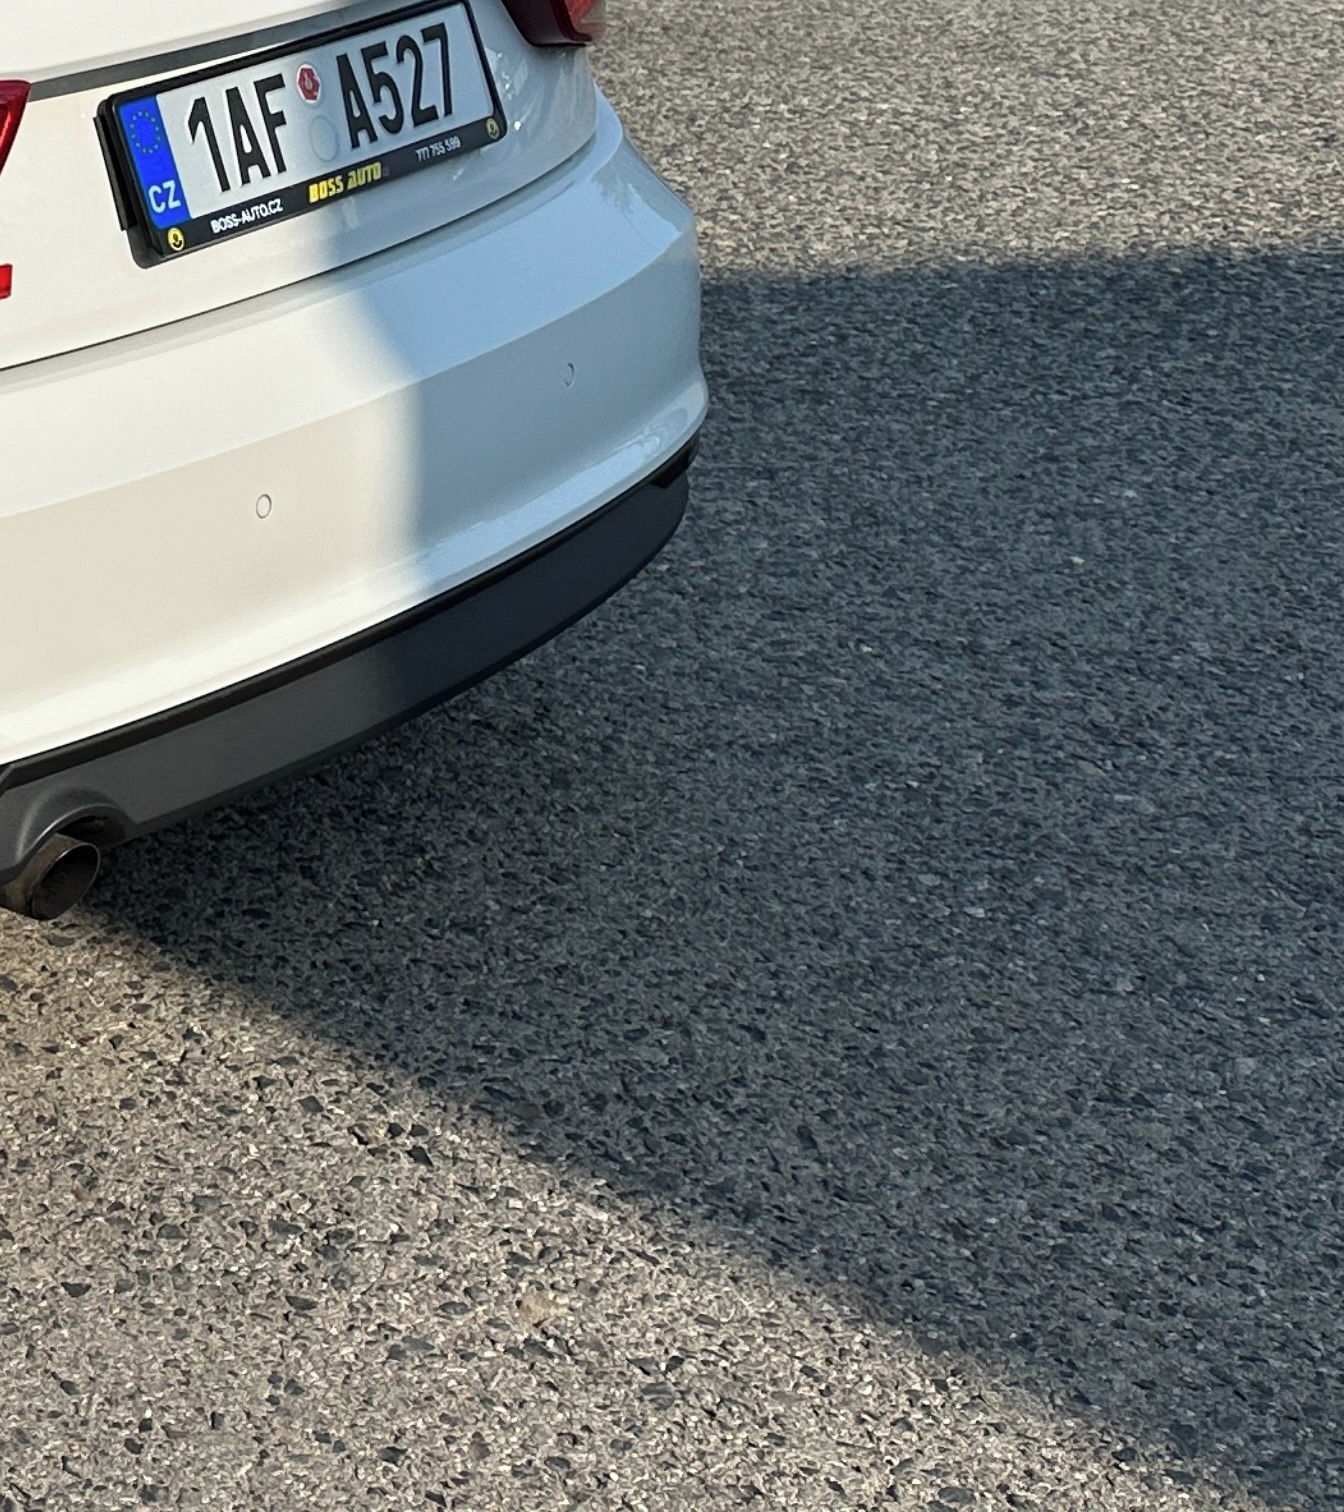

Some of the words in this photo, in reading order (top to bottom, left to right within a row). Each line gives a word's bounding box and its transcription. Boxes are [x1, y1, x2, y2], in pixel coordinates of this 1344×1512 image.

[187, 73, 288, 192] 1AF
[335, 22, 453, 149] A527
[148, 179, 181, 214] CZ
[309, 178, 345, 204] BOSS
[346, 161, 382, 190] AUTO
[210, 197, 284, 235] BOSS-AUTO.CZ
